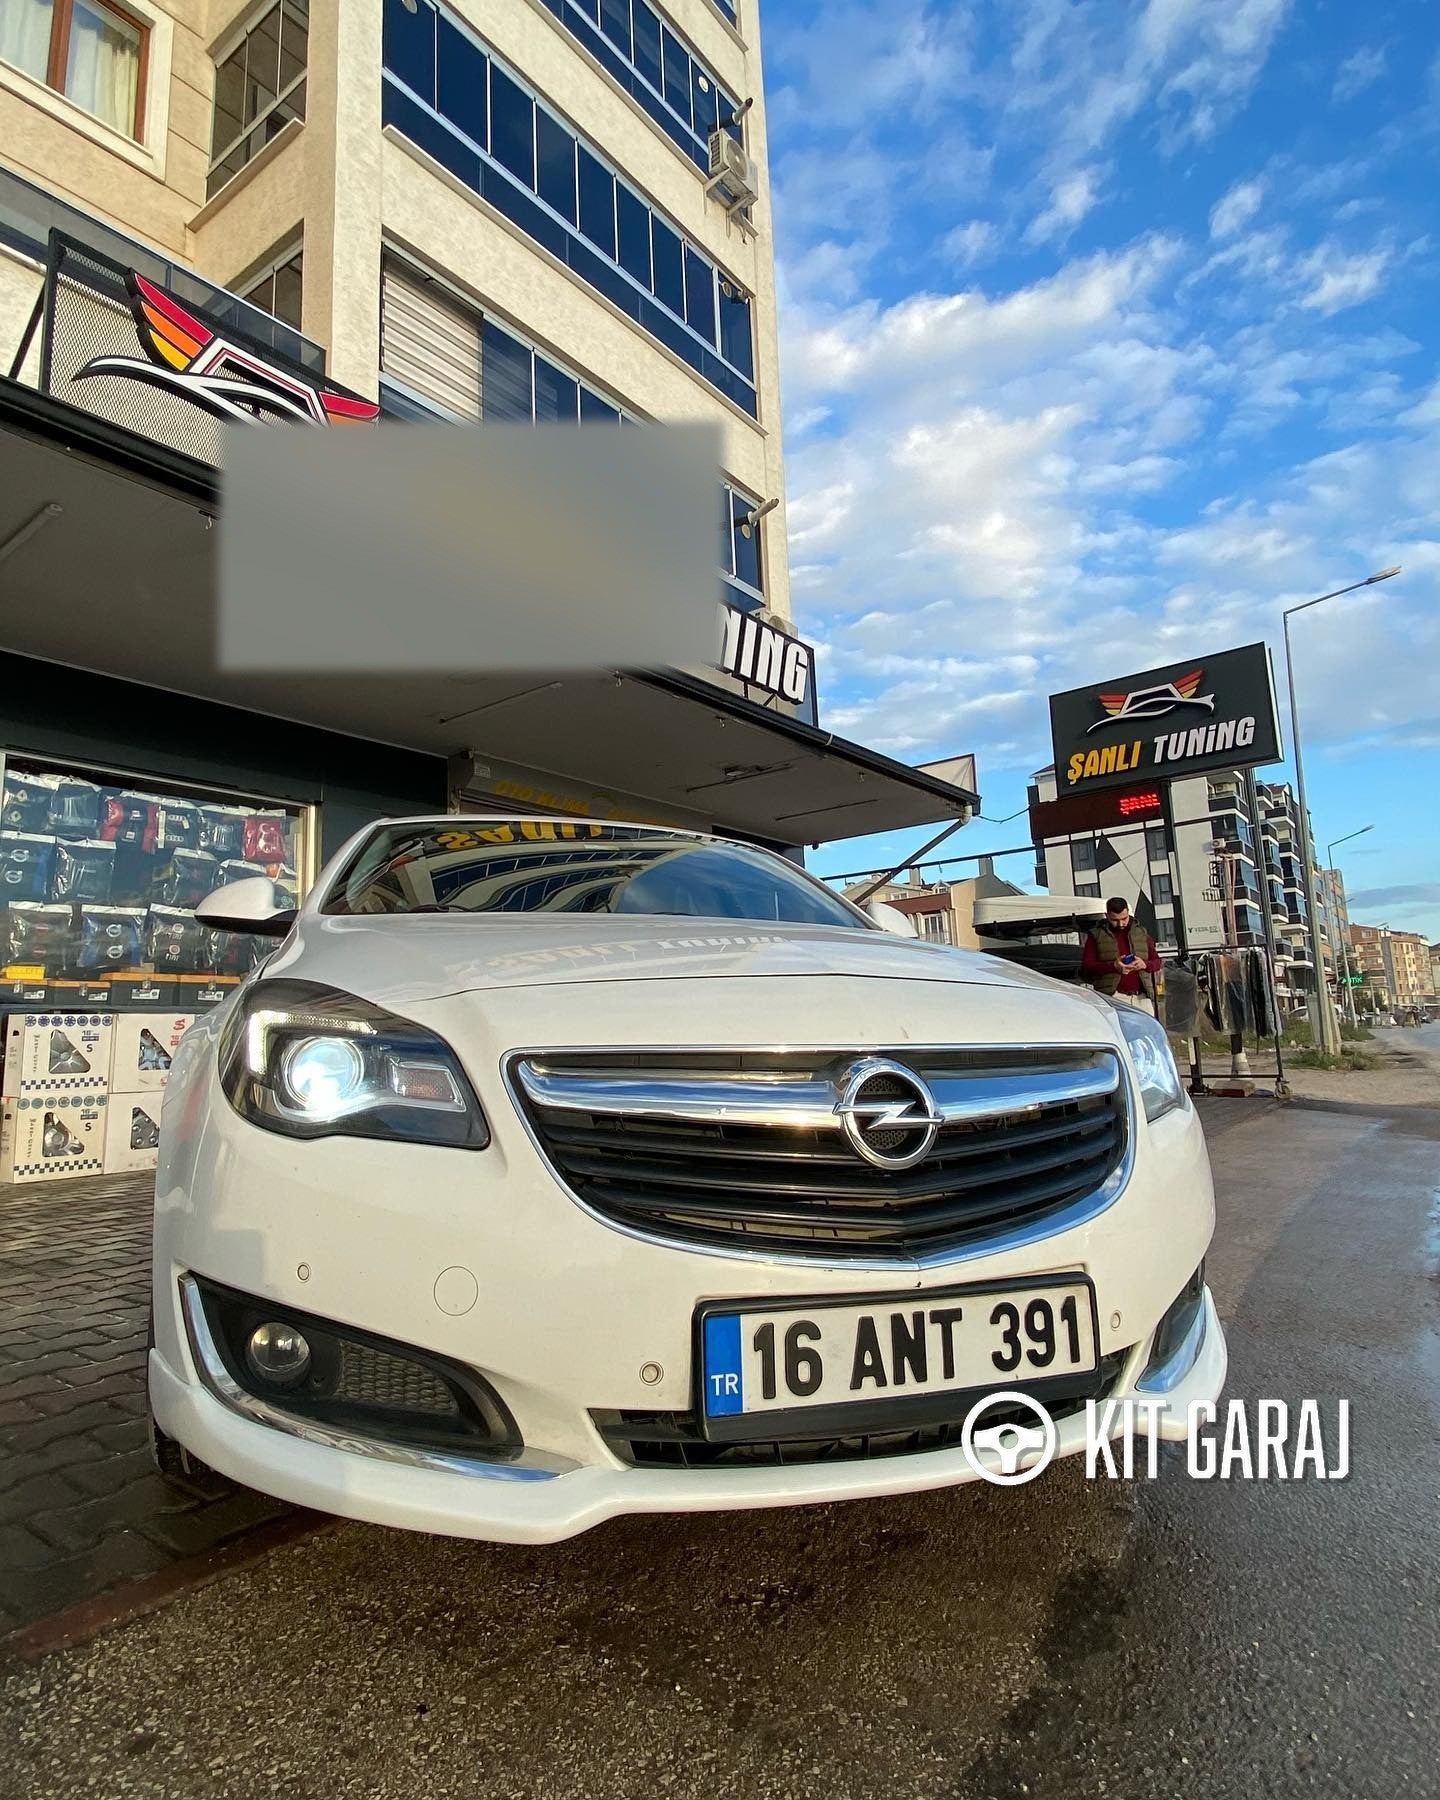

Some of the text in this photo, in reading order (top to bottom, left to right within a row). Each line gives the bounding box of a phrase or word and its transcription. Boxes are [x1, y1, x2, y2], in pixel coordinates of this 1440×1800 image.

[718, 602, 808, 703] NING
[1067, 740, 1143, 785] ŞANLI
[711, 1295, 1081, 1400] TR 16 ANT 391
